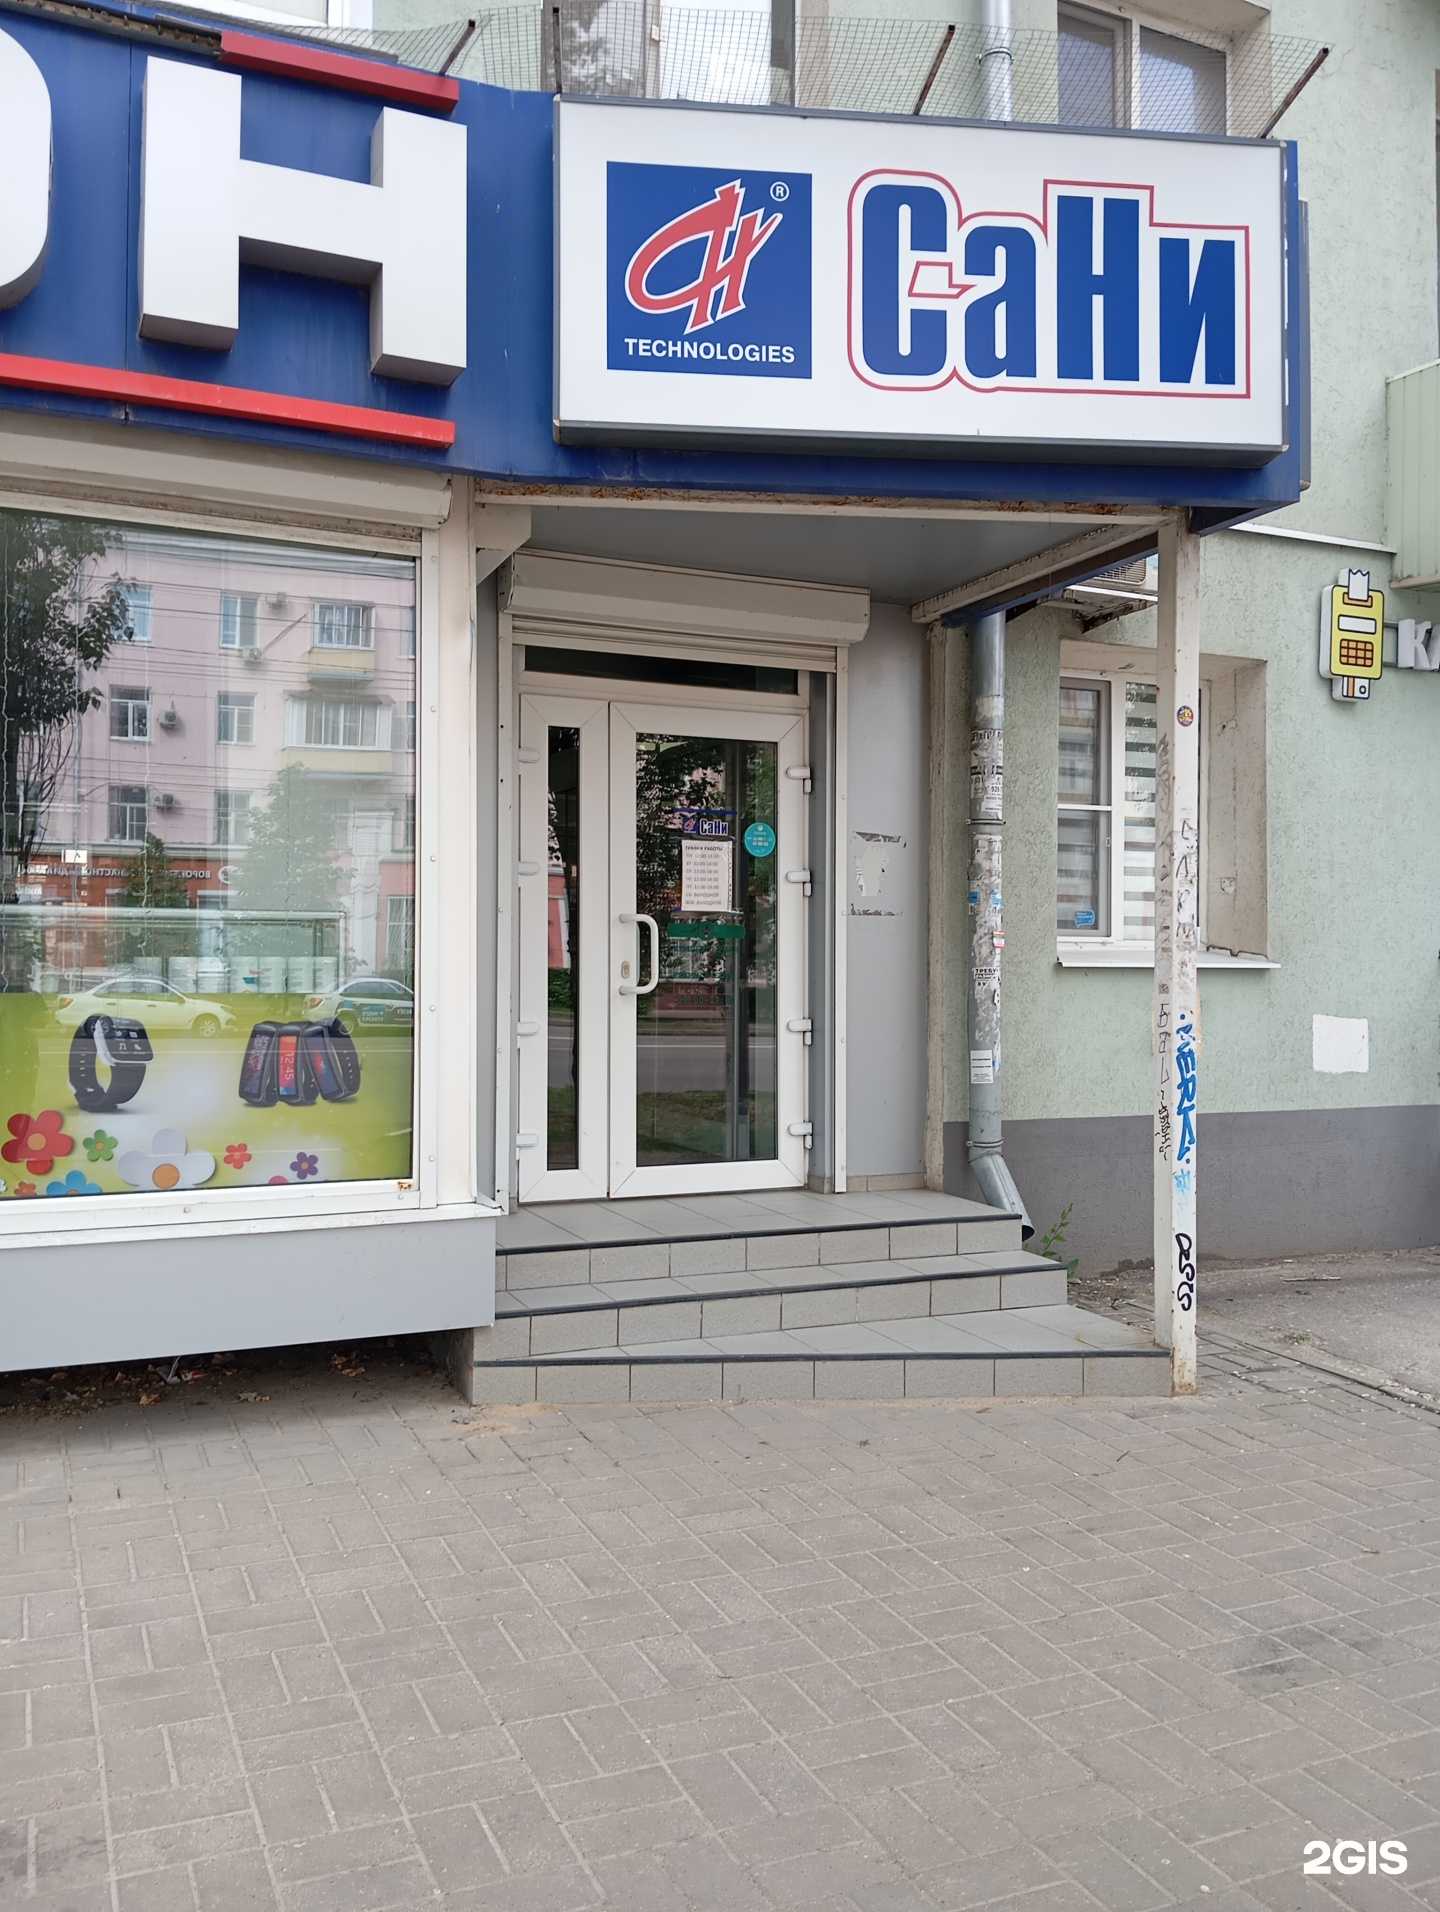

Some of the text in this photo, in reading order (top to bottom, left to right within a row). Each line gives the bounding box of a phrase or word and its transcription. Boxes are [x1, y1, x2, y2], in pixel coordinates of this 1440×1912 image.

[861, 183, 1236, 386] СаНи
[624, 336, 796, 364] TECHNOLOGIES
[700, 819, 728, 835] СаНи
